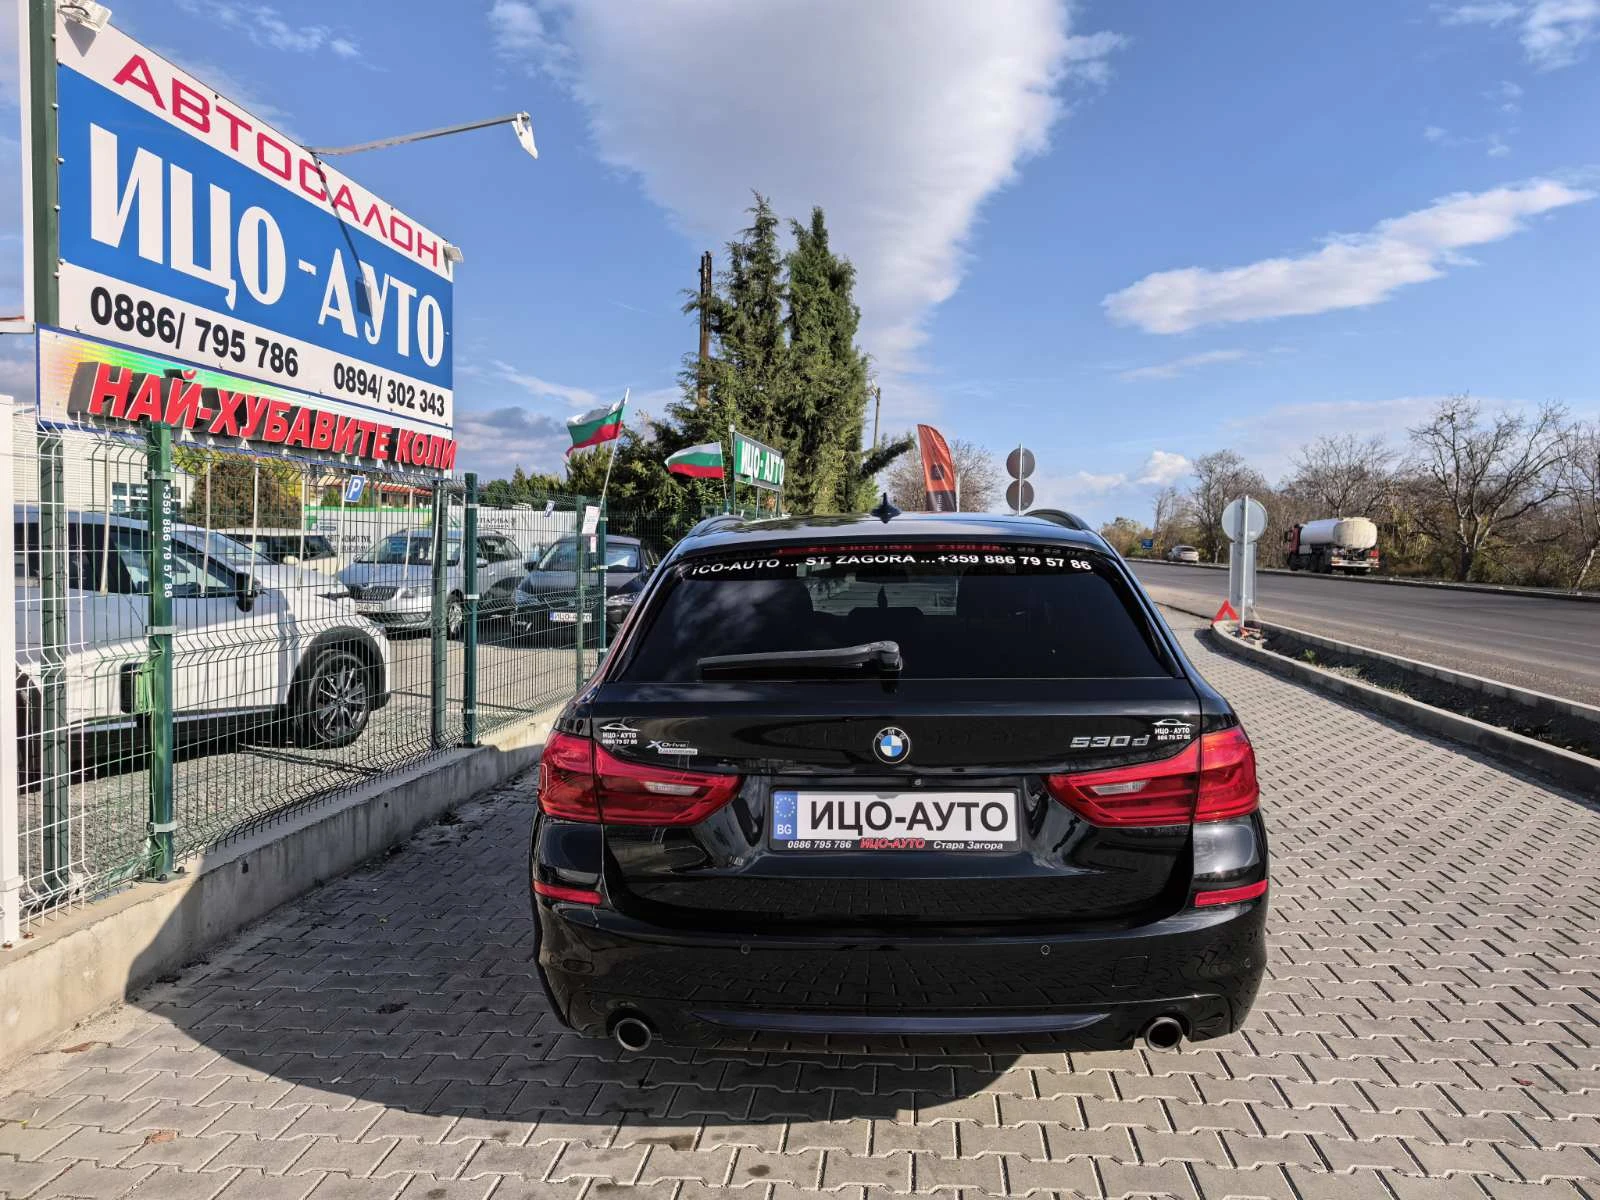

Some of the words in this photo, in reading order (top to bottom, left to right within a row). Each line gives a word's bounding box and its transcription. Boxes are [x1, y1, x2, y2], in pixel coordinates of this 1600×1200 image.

[113, 54, 438, 267] АВТОСАЛОН
[90, 286, 186, 349] 0886/
[195, 317, 246, 363] 795
[255, 336, 299, 378] 786
[333, 362, 383, 403] 0894/
[387, 379, 416, 406] 302
[420, 391, 445, 417] 343
[88, 361, 393, 461] НАЙ-ХУБАВИТЕ
[395, 428, 458, 470] КОЛИ
[741, 441, 785, 485] ИЦО-АУТО
[348, 478, 362, 498] P
[162, 484, 172, 514] +359
[162, 519, 172, 541] 886
[163, 545, 172, 560] 79
[805, 556, 832, 566] ST.
[835, 555, 915, 565] ZAGORA
[984, 556, 1016, 565] 886
[1019, 556, 1041, 566] 79
[1046, 558, 1065, 567] 57
[1070, 559, 1092, 570] 86
[163, 564, 173, 579] 57
[164, 583, 173, 598] 86
[811, 801, 1008, 836] ИЦО-АУТО
[776, 824, 792, 835] BG
[787, 840, 811, 849] 0886
[814, 840, 832, 849] 795
[834, 840, 852, 849] 786
[860, 837, 925, 850] ИЦО-АУТО
[933, 840, 964, 850] Стара
[967, 840, 1003, 851] Загора
